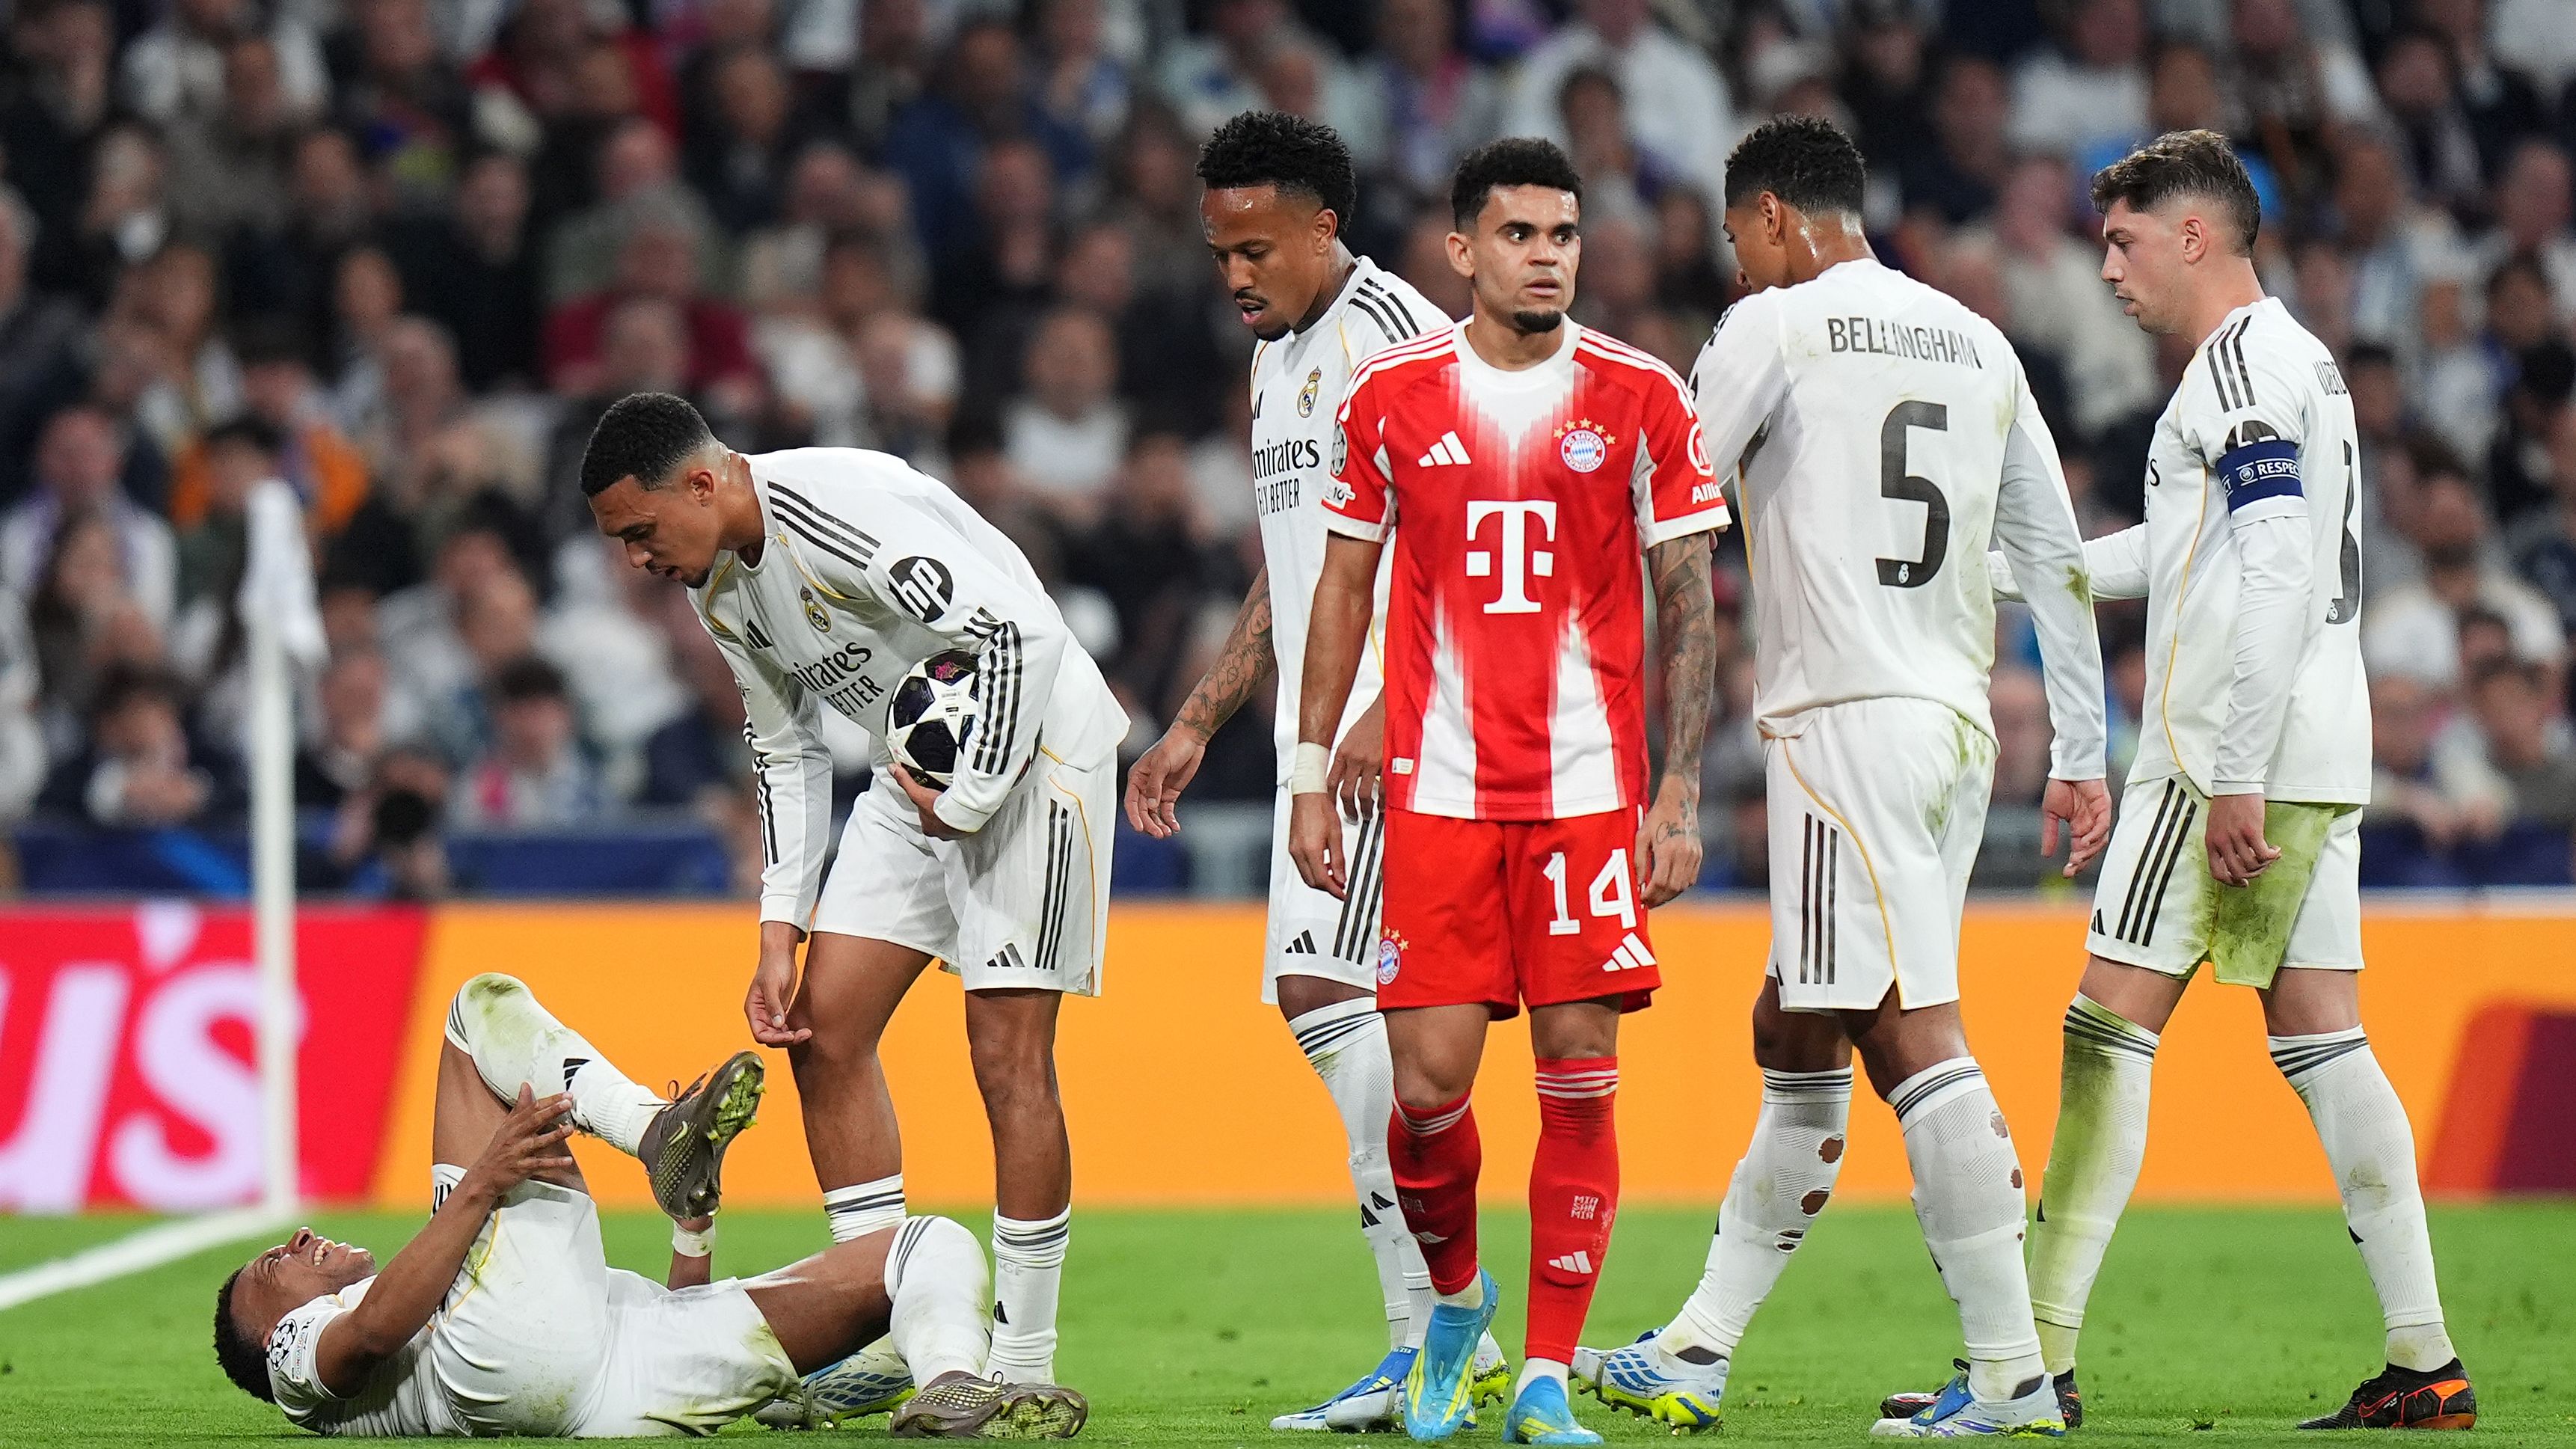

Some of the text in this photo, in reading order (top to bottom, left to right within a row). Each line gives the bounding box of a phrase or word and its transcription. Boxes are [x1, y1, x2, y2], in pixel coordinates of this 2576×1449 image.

[1827, 317, 1983, 370] BELLINGHAM
[1253, 437, 1320, 480] mirates
[2257, 461, 2301, 477] RESPEC
[1270, 477, 1300, 513] BETTER
[1875, 399, 1950, 589] 5
[1465, 500, 1557, 614] T
[888, 557, 953, 623] hp
[791, 641, 872, 693] irates
[1542, 848, 1637, 937] 14
